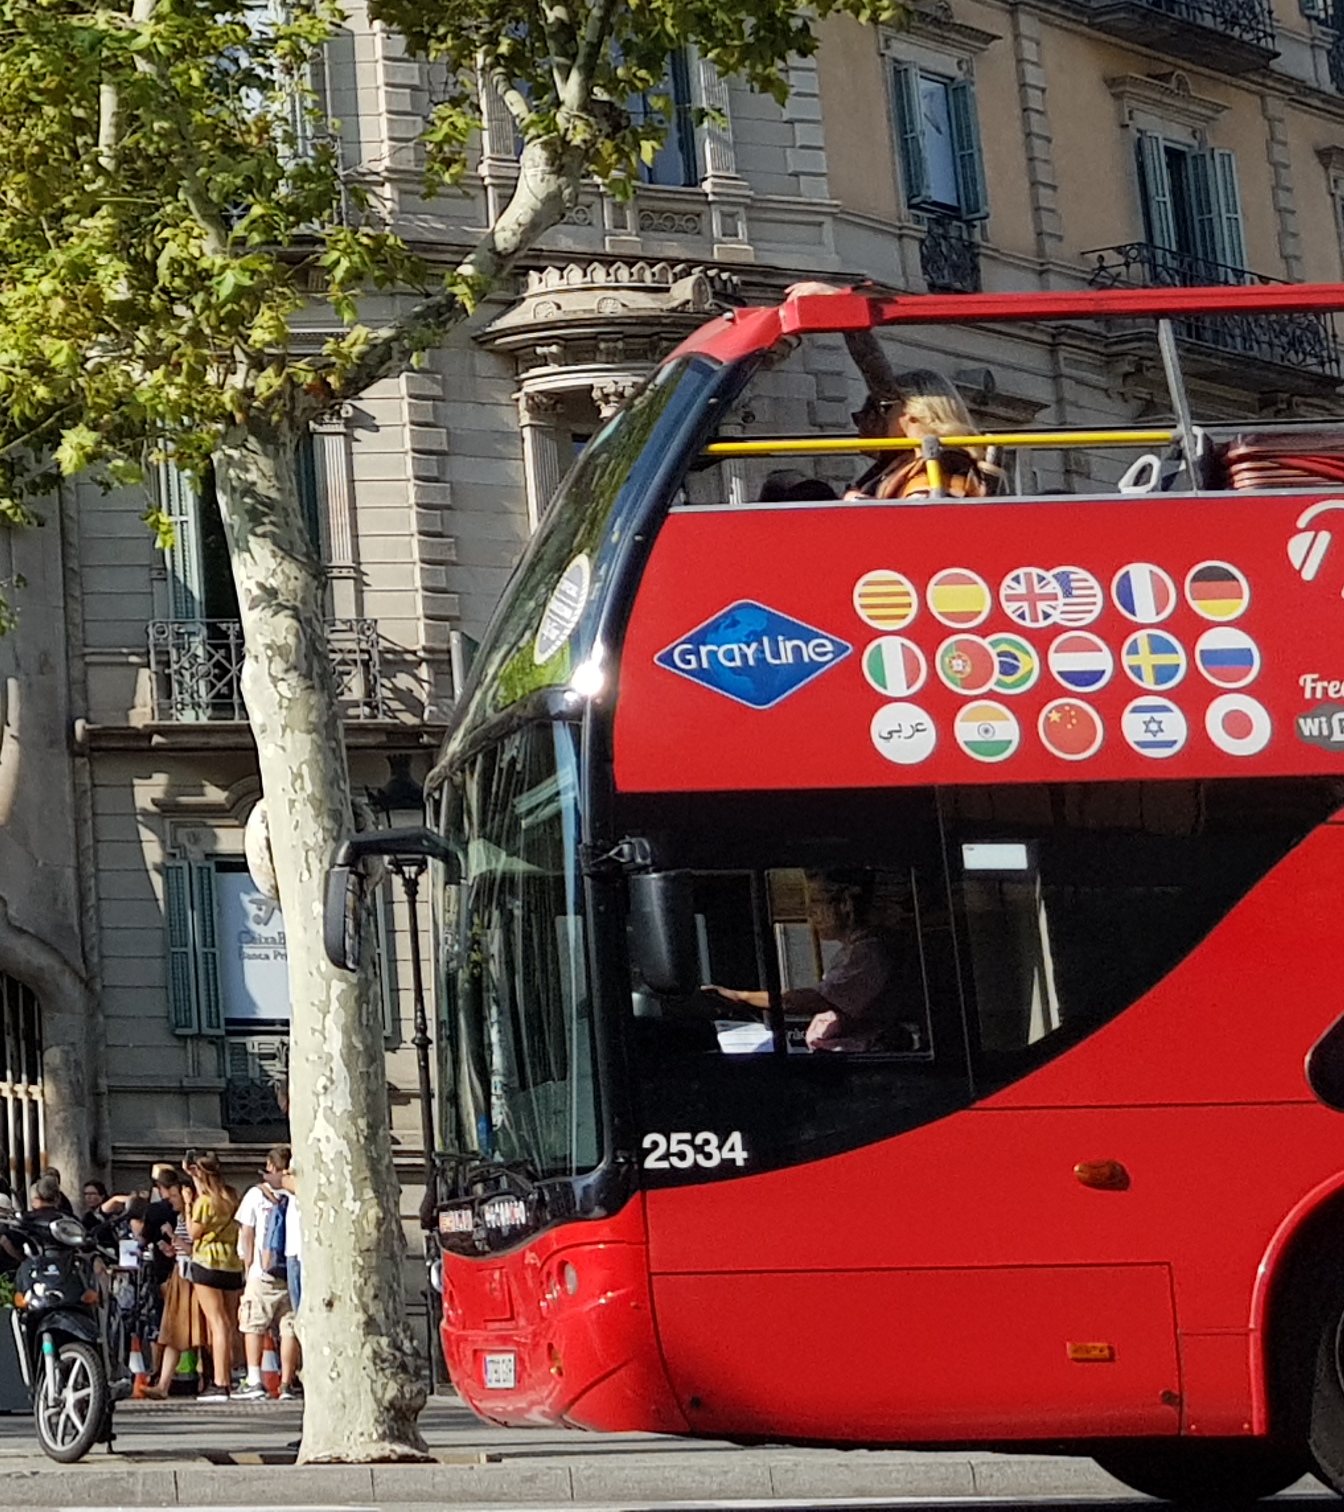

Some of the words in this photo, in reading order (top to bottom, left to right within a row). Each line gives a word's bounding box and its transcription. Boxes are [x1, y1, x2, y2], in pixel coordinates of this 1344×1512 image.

[1298, 673, 1344, 700] Fre
[878, 722, 928, 743] عربي
[642, 1131, 748, 1169] 2534
